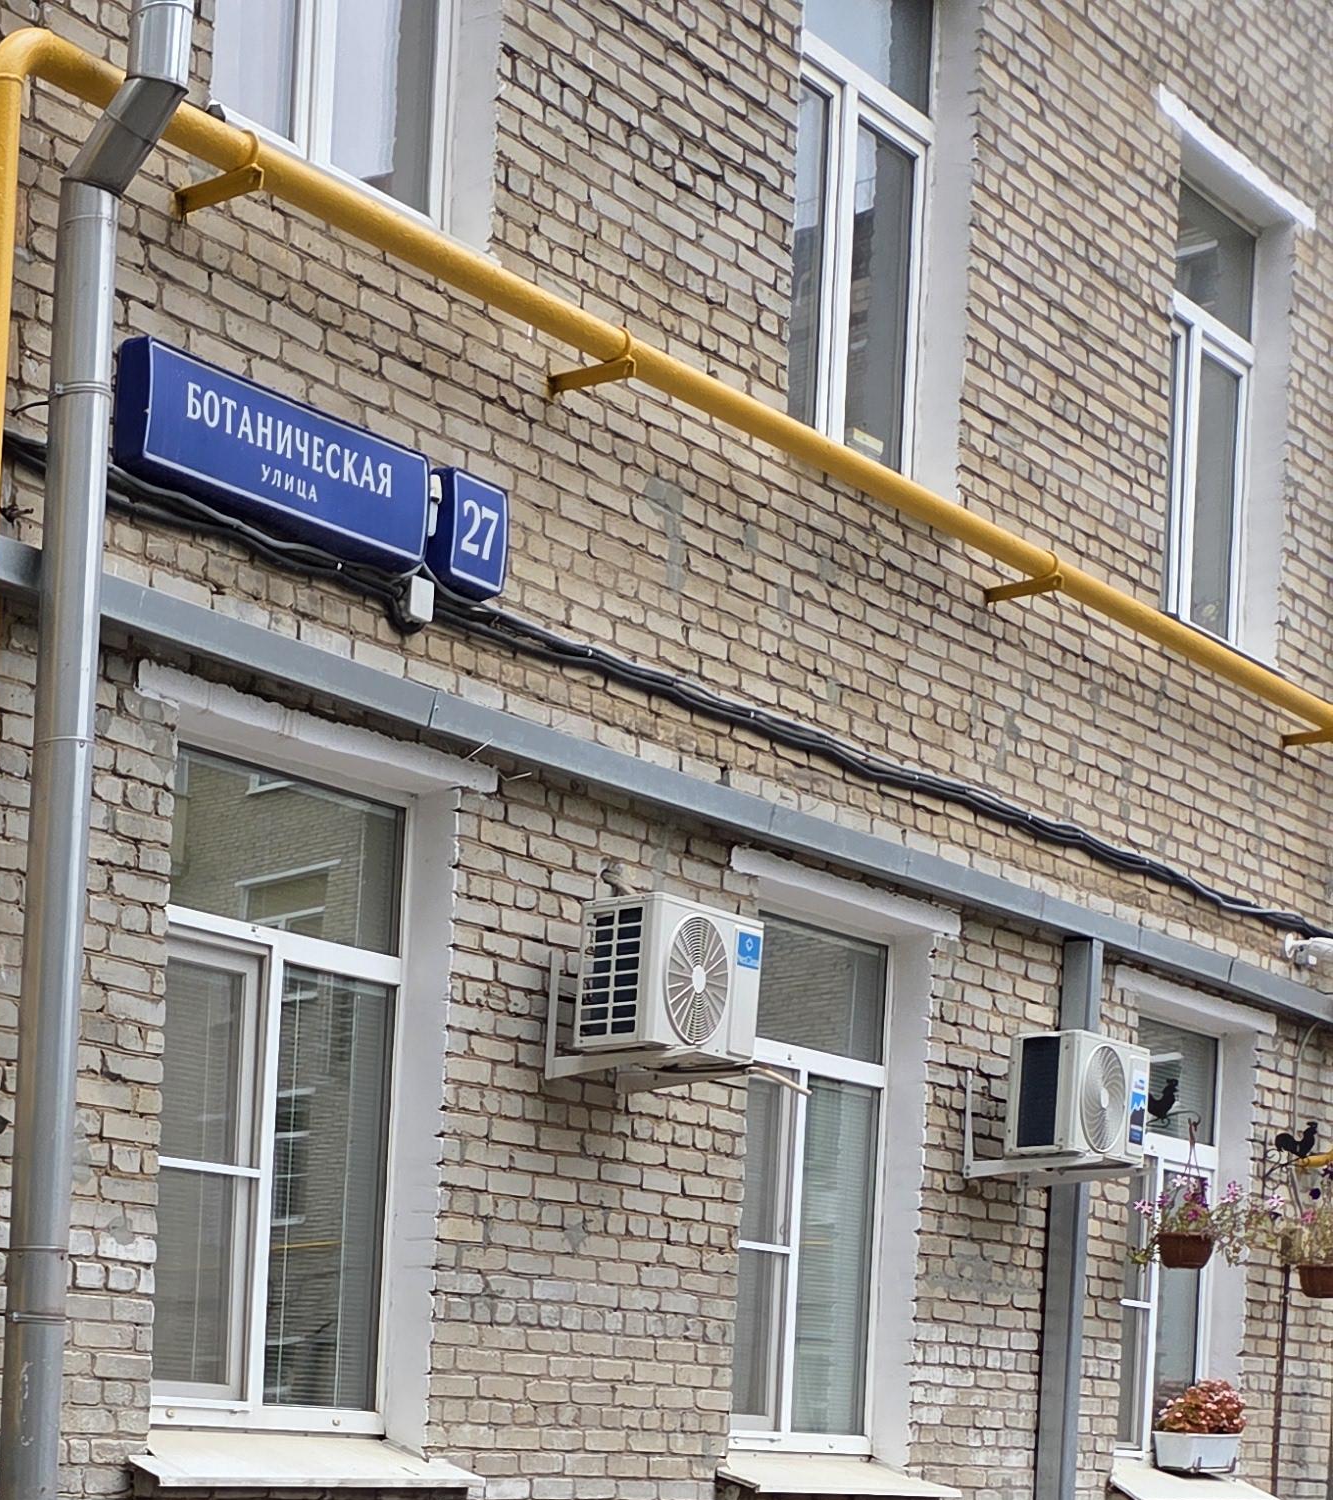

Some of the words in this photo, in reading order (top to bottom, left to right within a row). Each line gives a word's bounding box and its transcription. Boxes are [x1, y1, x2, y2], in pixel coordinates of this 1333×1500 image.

[186, 381, 393, 498] БОТАНИЧЕСКАЯ
[260, 463, 318, 503] УЛИЦА
[460, 499, 500, 561] 27
